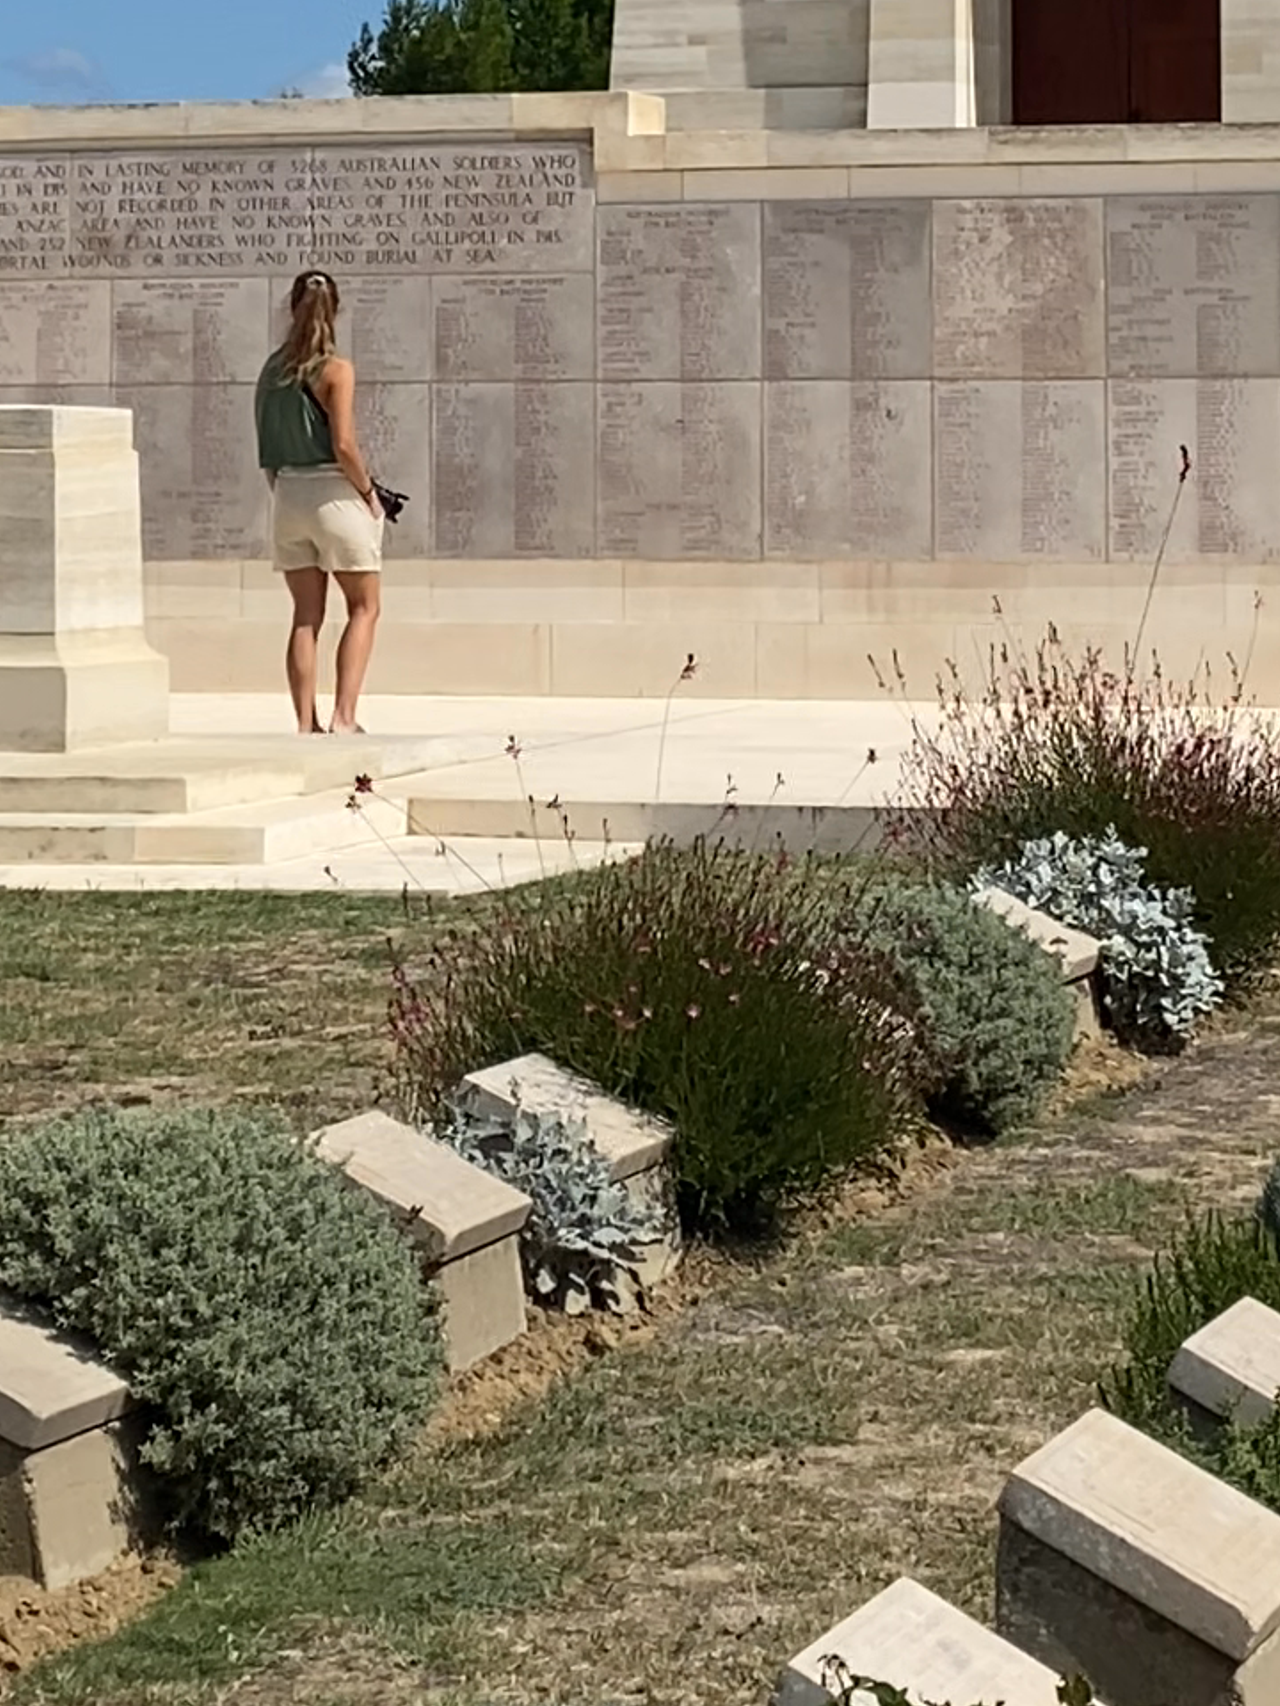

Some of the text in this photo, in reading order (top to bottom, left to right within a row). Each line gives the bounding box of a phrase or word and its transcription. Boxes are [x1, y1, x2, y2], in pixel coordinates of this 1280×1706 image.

[33, 165, 66, 179] AND
[78, 164, 94, 178] IN
[106, 162, 170, 177] LASTING
[182, 161, 246, 175] MEMORY
[258, 160, 276, 174] OF
[338, 157, 440, 172] AUSTRALIAN
[453, 156, 522, 170] SOLDIERS
[531, 155, 576, 169] WHO
[17, 183, 32, 197] IN
[80, 181, 112, 195] AND
[122, 181, 165, 195] HAVE
[177, 180, 200, 194] NO
[211, 178, 274, 192] KNOWN
[363, 176, 396, 190] AND
[443, 175, 480, 189] NEW
[495, 173, 576, 188] ZEALAND
[76, 201, 104, 214] NOT
[119, 199, 198, 213] RECORDED
[209, 198, 225, 211] IN
[238, 197, 291, 211] OTHER
[307, 193, 354, 211] AREAS
[366, 194, 386, 208] OF
[400, 194, 432, 208] THE
[445, 192, 533, 208] PENINSULA
[547, 192, 575, 207] BUT
[16, 219, 66, 232] ANZAC
[80, 219, 120, 232] AREA
[134, 218, 165, 230] AND
[177, 216, 218, 230] HAVE
[232, 216, 255, 229] NO
[267, 215, 331, 229] KNOWN
[344, 213, 406, 228] GRAVES
[422, 212, 455, 227] AND
[469, 212, 510, 226] ALSO
[522, 210, 542, 225] OF
[0, 238, 29, 252] AND
[39, 237, 66, 251] 252
[76, 236, 113, 249] NEW
[124, 234, 224, 249] ZEALANDERS
[235, 234, 275, 247] WHO
[287, 231, 363, 247] FIGHTING
[376, 231, 399, 245] ON
[412, 230, 495, 245] GALLIPOLI
[507, 229, 524, 244] IN
[62, 255, 131, 268] WOUNDS
[143, 254, 164, 267] OR
[175, 252, 243, 267] SICKNESS
[255, 252, 288, 266] AND
[299, 250, 355, 266] FOUND
[366, 250, 417, 265] BURIAL
[433, 249, 454, 263] AT
[466, 249, 496, 264] SEA
